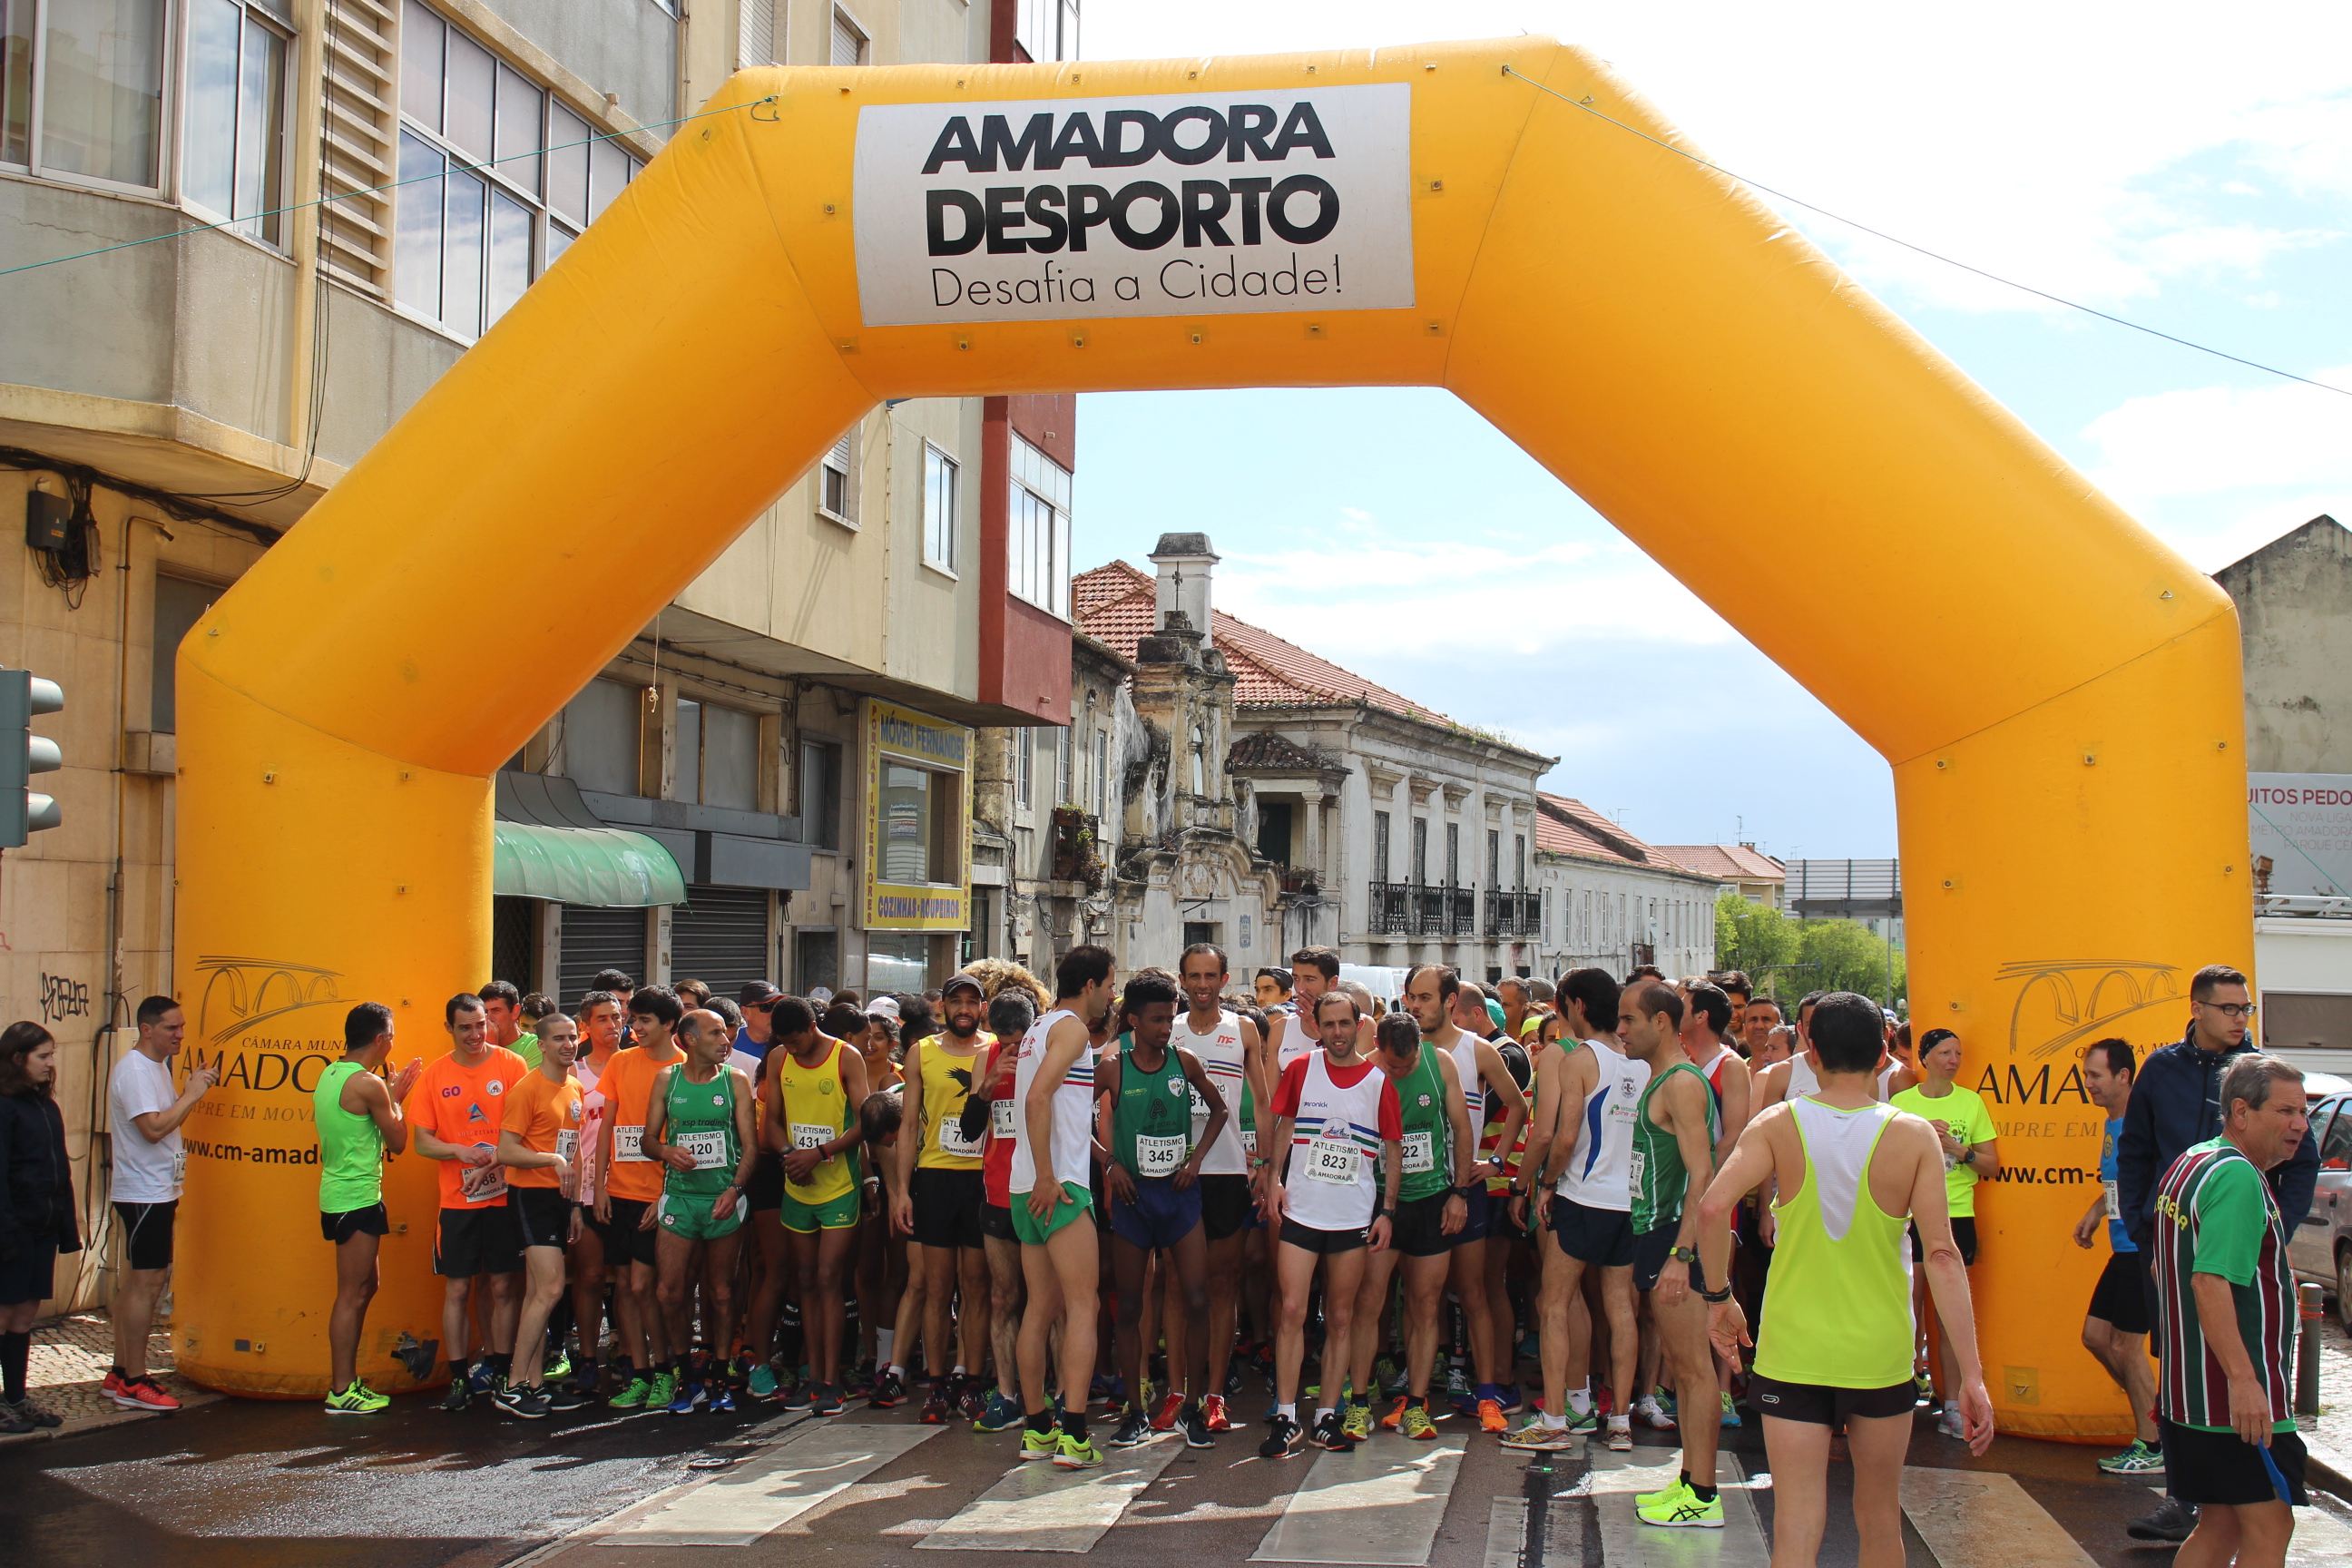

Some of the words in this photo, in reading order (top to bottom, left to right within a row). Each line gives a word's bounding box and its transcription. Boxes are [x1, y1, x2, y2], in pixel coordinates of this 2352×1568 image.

[921, 102, 1336, 174] AMADORA
[926, 174, 1340, 257] DESPORTO
[932, 260, 1095, 307] Desafia
[1114, 275, 1141, 301] a
[1160, 252, 1343, 299] Cidade!
[881, 710, 914, 749] MÓVEIS
[916, 724, 965, 761] FERNANDES
[2290, 812, 2323, 823] NOVA
[2251, 825, 2292, 836] METRO
[2284, 839, 2331, 850] PARQUE
[867, 791, 876, 924] INTERIORES
[242, 1036, 301, 1050] CÂMARA
[442, 1086, 461, 1098] GO
[230, 1104, 256, 1120] EM
[681, 1119, 696, 1128] xsp
[698, 1118, 726, 1129] trading
[1404, 1121, 1435, 1132] trading
[793, 1125, 832, 1135] ATLETISMO
[1995, 1122, 2056, 1138] MPRE
[2063, 1122, 2097, 1137] EM
[679, 1132, 721, 1142] ATLETISMO
[799, 1136, 819, 1148] 431
[1140, 1137, 1183, 1147] ATLETISMO
[690, 1142, 712, 1155] 120
[1313, 1141, 1358, 1155] ATLETISMO
[1402, 1145, 1419, 1158] 22
[1149, 1150, 1173, 1162] 345
[1321, 1153, 1347, 1169] 823
[1318, 1171, 1346, 1181] AMADORA
